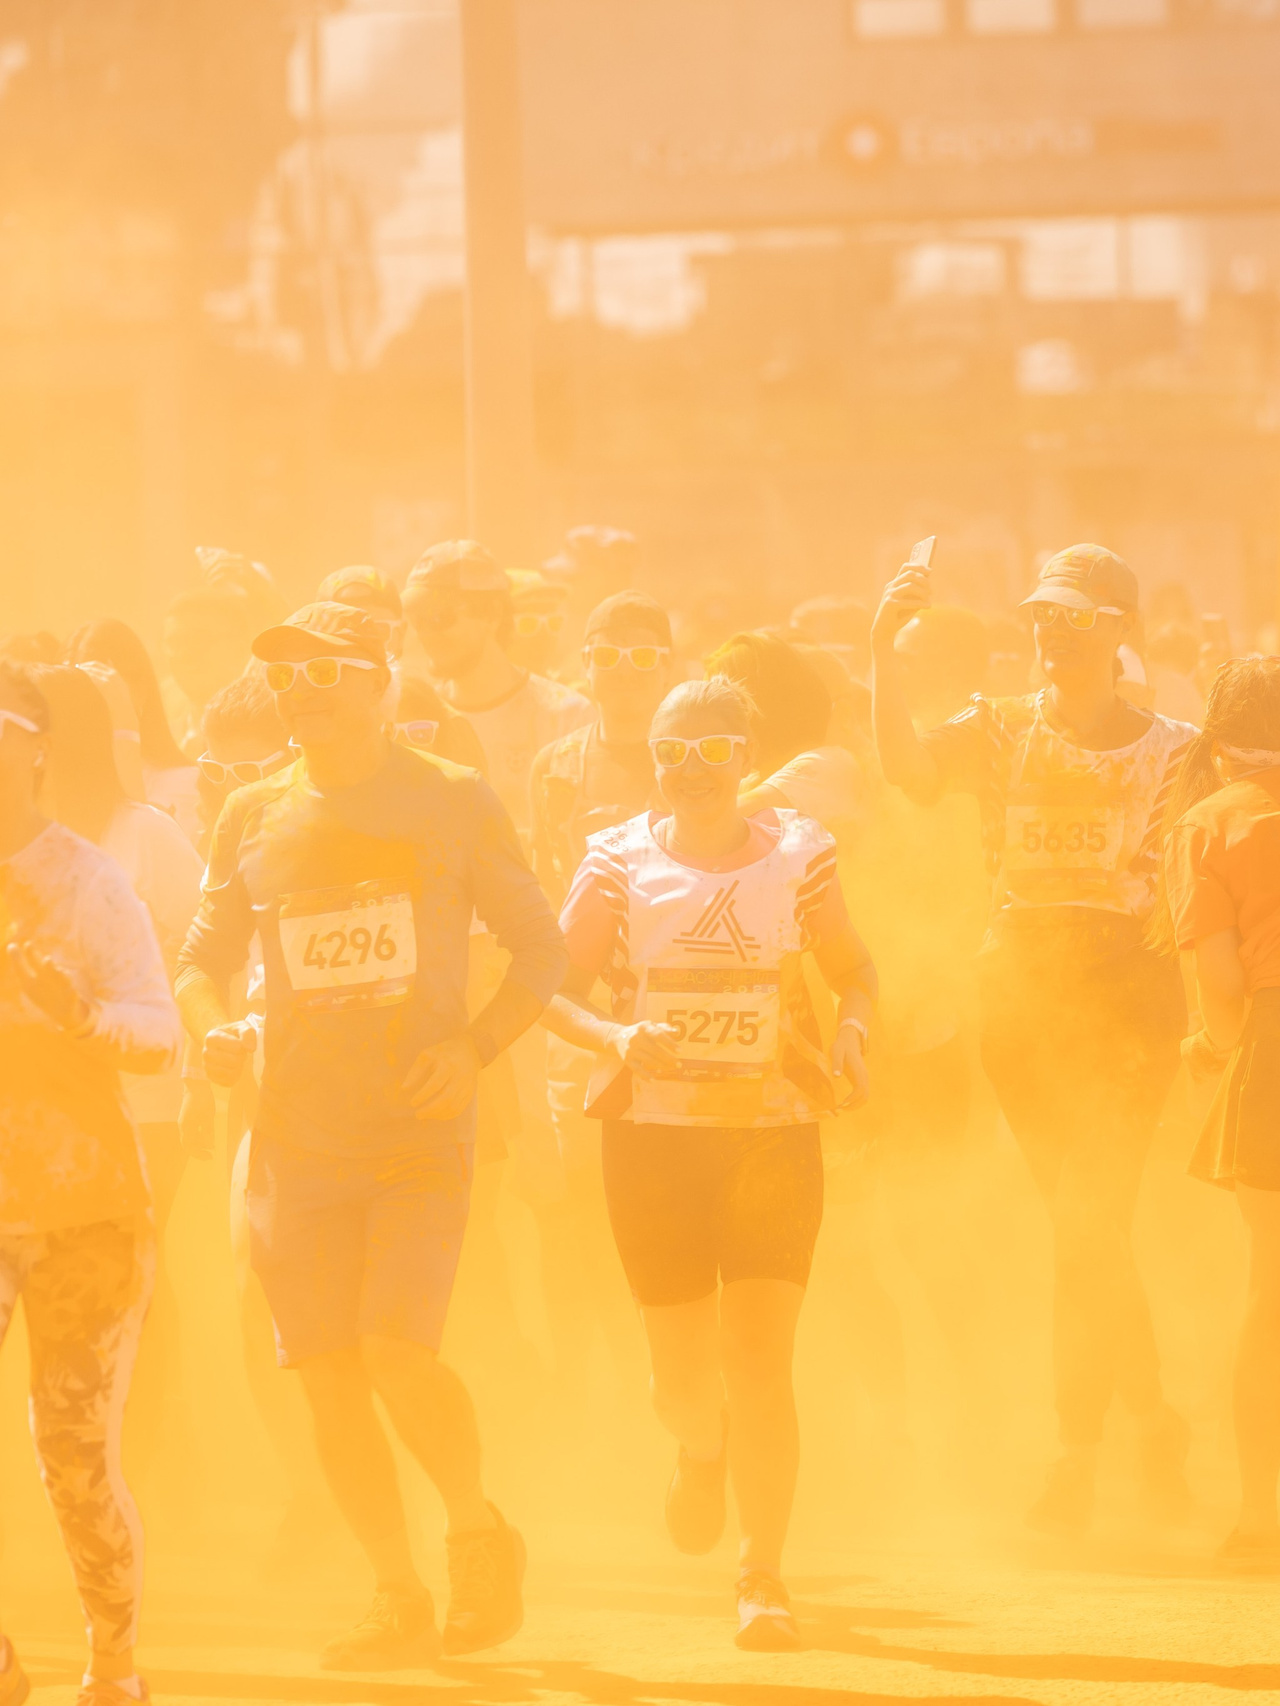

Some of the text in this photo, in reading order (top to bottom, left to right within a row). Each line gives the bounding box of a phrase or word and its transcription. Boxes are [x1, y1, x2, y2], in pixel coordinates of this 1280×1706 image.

[1022, 819, 1107, 854] 5635
[302, 923, 397, 971] 4296
[665, 1009, 760, 1047] 5275
